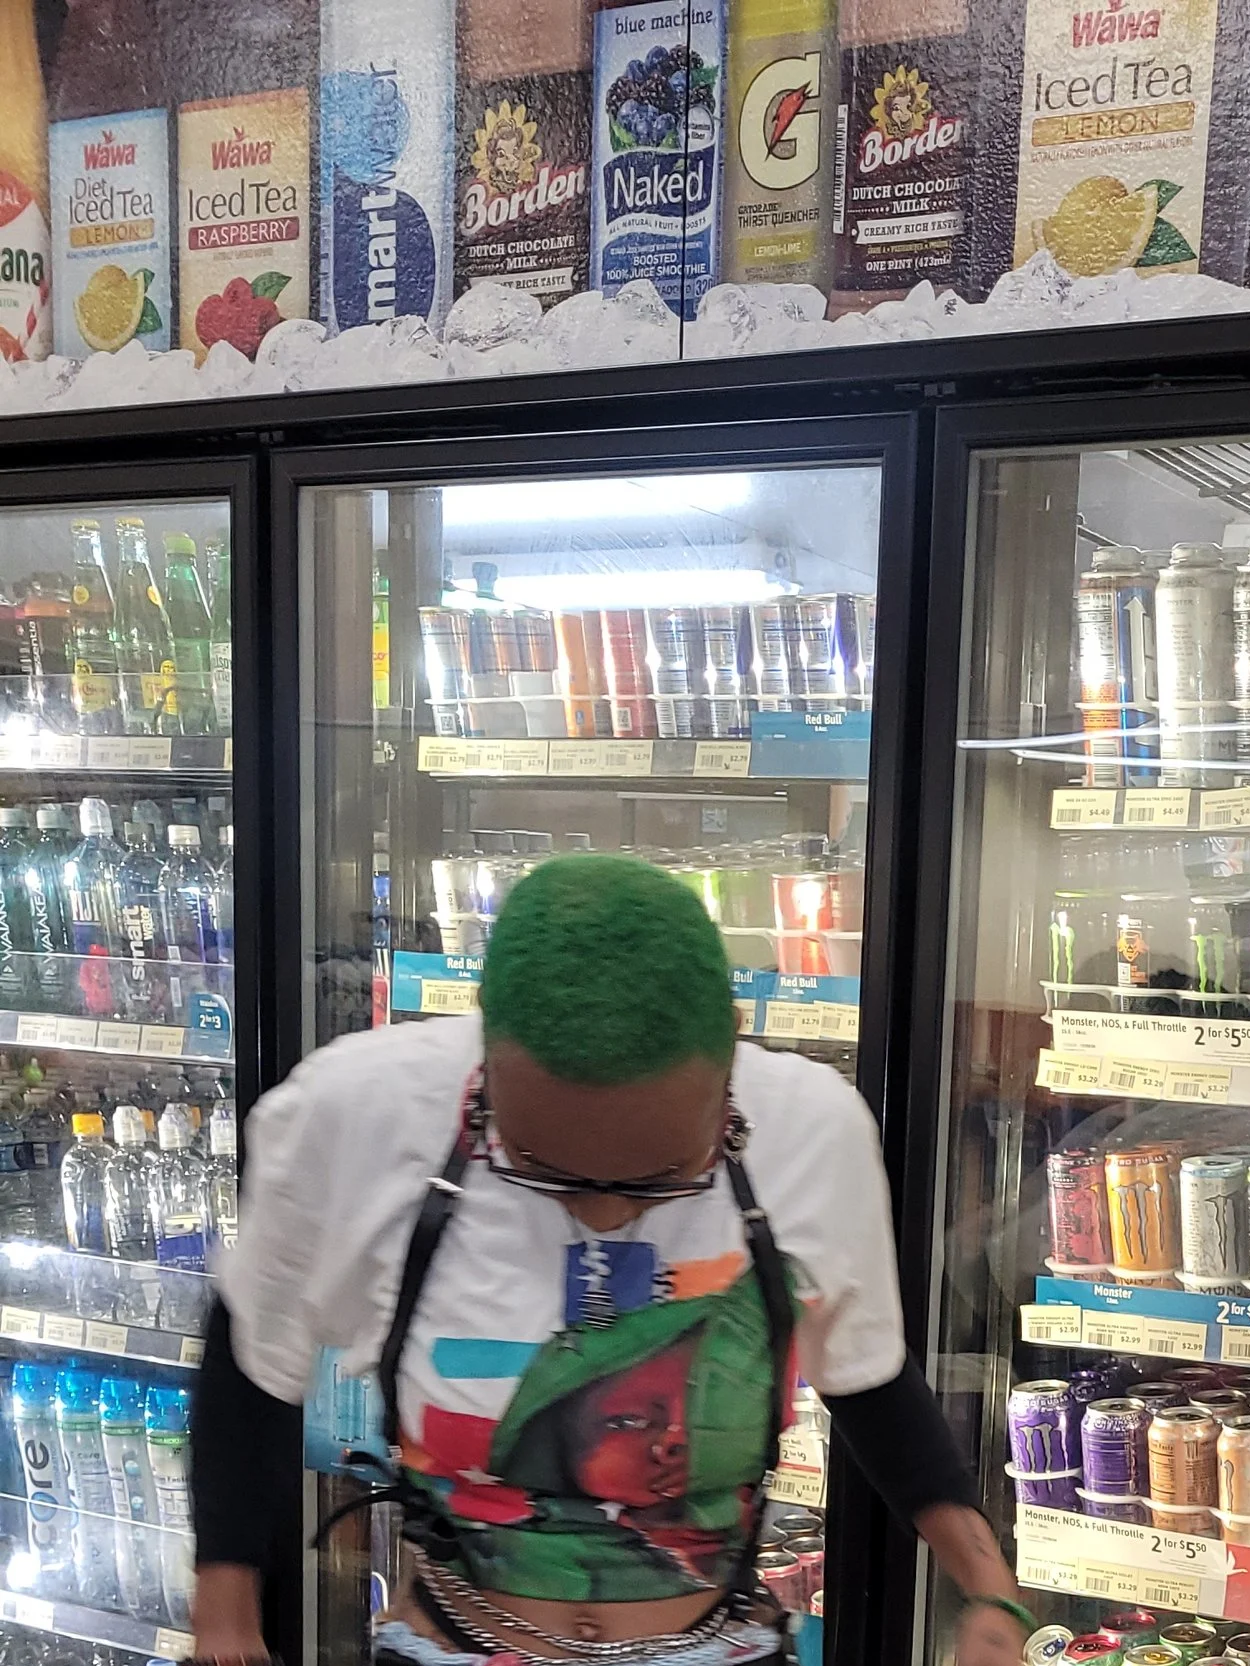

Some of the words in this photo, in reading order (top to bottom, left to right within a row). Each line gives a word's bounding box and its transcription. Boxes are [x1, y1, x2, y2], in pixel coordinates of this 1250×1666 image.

[616, 18, 645, 35] blue
[1073, 10, 1161, 48] Wawa
[1035, 56, 1118, 111] Iced
[1124, 57, 1192, 99] Tea
[738, 51, 821, 191] G
[1064, 112, 1158, 139] LEMON
[84, 143, 137, 171] Wawa
[211, 139, 273, 170] Wawa
[75, 178, 107, 199] Diet
[613, 160, 705, 209] Naked
[852, 187, 892, 200] DUTCH
[69, 187, 114, 224] Iced
[117, 187, 153, 216] Tea
[188, 178, 245, 222] Iced
[249, 178, 298, 214] Tea
[460, 164, 585, 235] Borden
[738, 202, 778, 214] GATORADE
[892, 198, 929, 214] MILK
[738, 214, 768, 228] THIRST
[771, 208, 820, 227] QUENCHER
[864, 225, 902, 237] CREAMY
[905, 221, 929, 233] RICH
[931, 218, 959, 231] TASTE
[86, 227, 139, 245] LEMON
[197, 220, 291, 249] RASPBERRY
[469, 242, 505, 257] DUTCH
[507, 235, 576, 254] CHOCOLATE
[754, 242, 802, 257] LEMON-LIME
[506, 254, 538, 269] MILK
[866, 261, 886, 271] ONE
[805, 713, 822, 725] Red
[823, 712, 843, 725] Bull
[123, 905, 146, 981] smart
[1061, 1016, 1099, 1029] Monster,
[1101, 1018, 1122, 1030] NOS,
[1124, 1021, 1130, 1029] &
[1132, 1020, 1149, 1031] Full
[1152, 1021, 1187, 1033] Throttle
[1194, 1026, 1206, 1046] 2
[1208, 1028, 1222, 1038] for
[1094, 1284, 1133, 1299] Monster
[1216, 1301, 1230, 1324] 2
[1231, 1304, 1245, 1316] for
